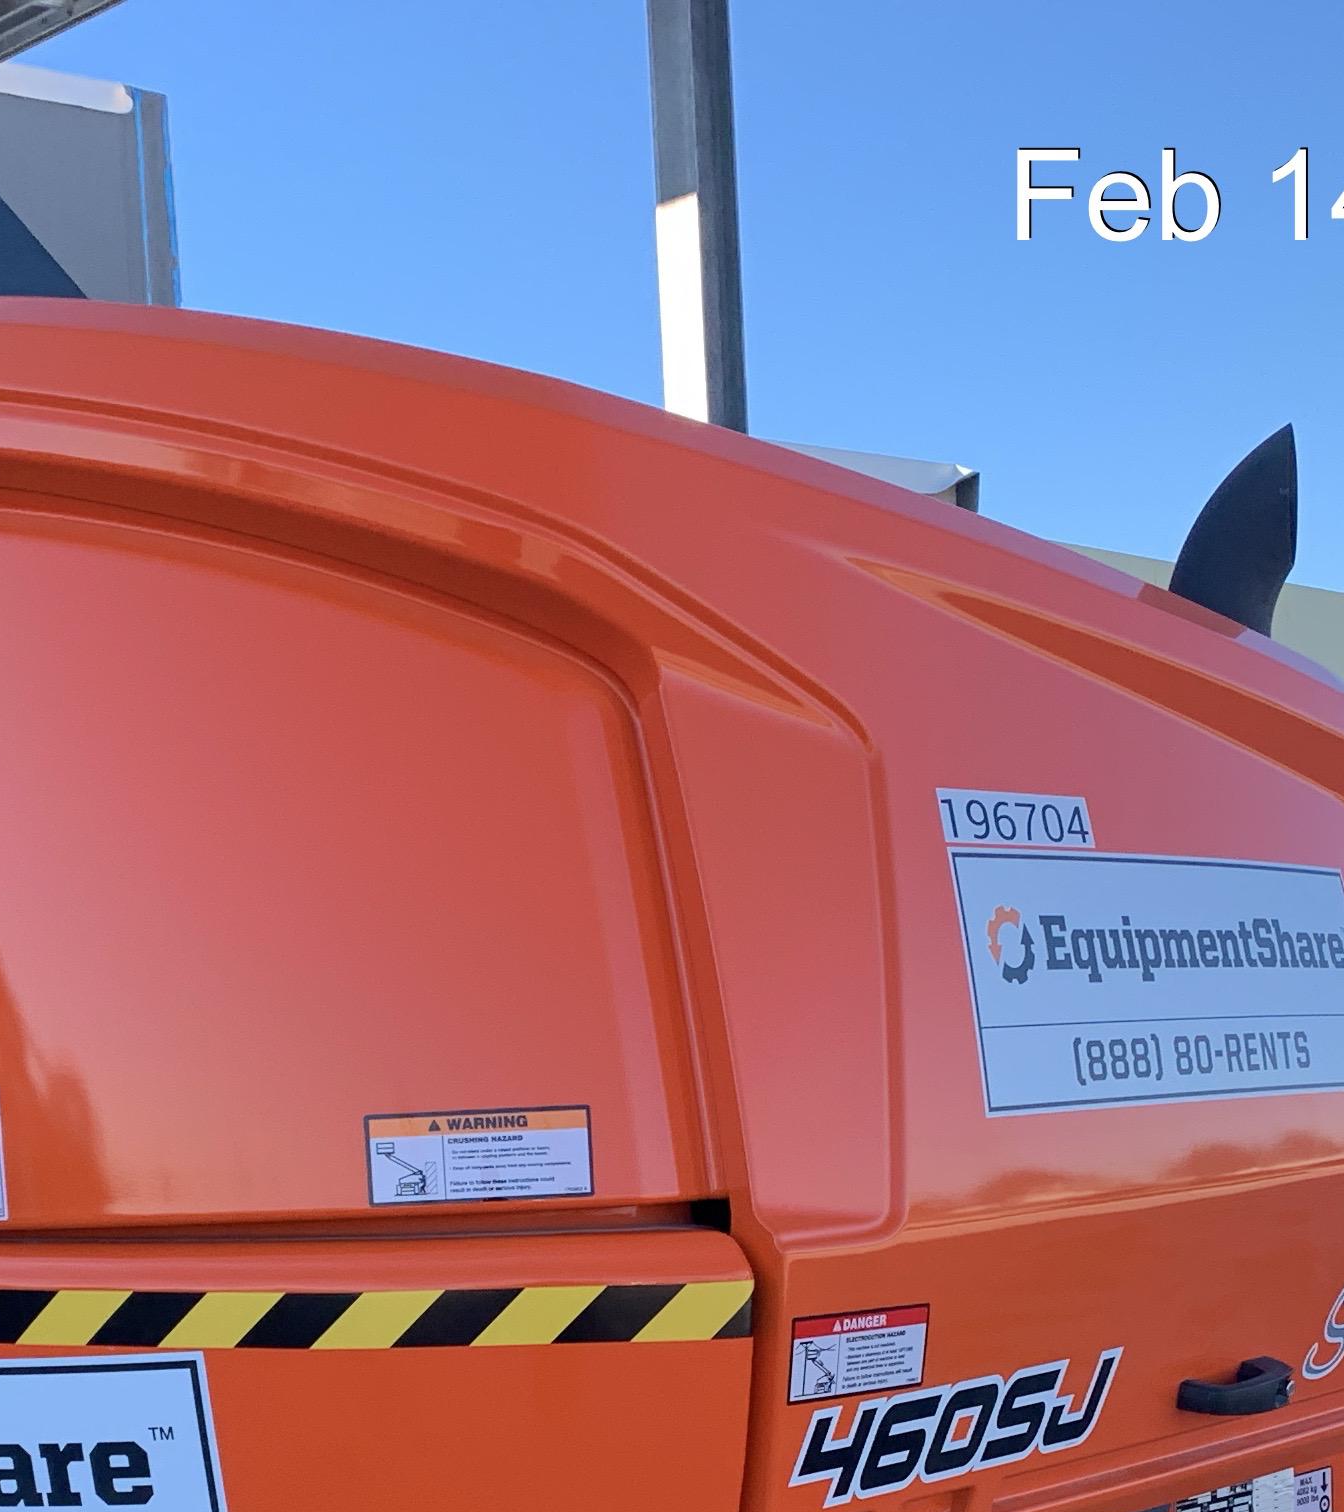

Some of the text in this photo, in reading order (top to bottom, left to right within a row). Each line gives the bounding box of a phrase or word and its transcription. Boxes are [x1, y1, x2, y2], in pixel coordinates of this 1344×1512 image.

[940, 798, 1090, 844] 196704
[1073, 1031, 1311, 1085] (888) 80-RENTS
[447, 1115, 528, 1130] WARNING
[448, 1136, 489, 1144] CRUSHING
[843, 1314, 887, 1331] DANGER
[791, 1349, 1122, 1506] 460SJ
